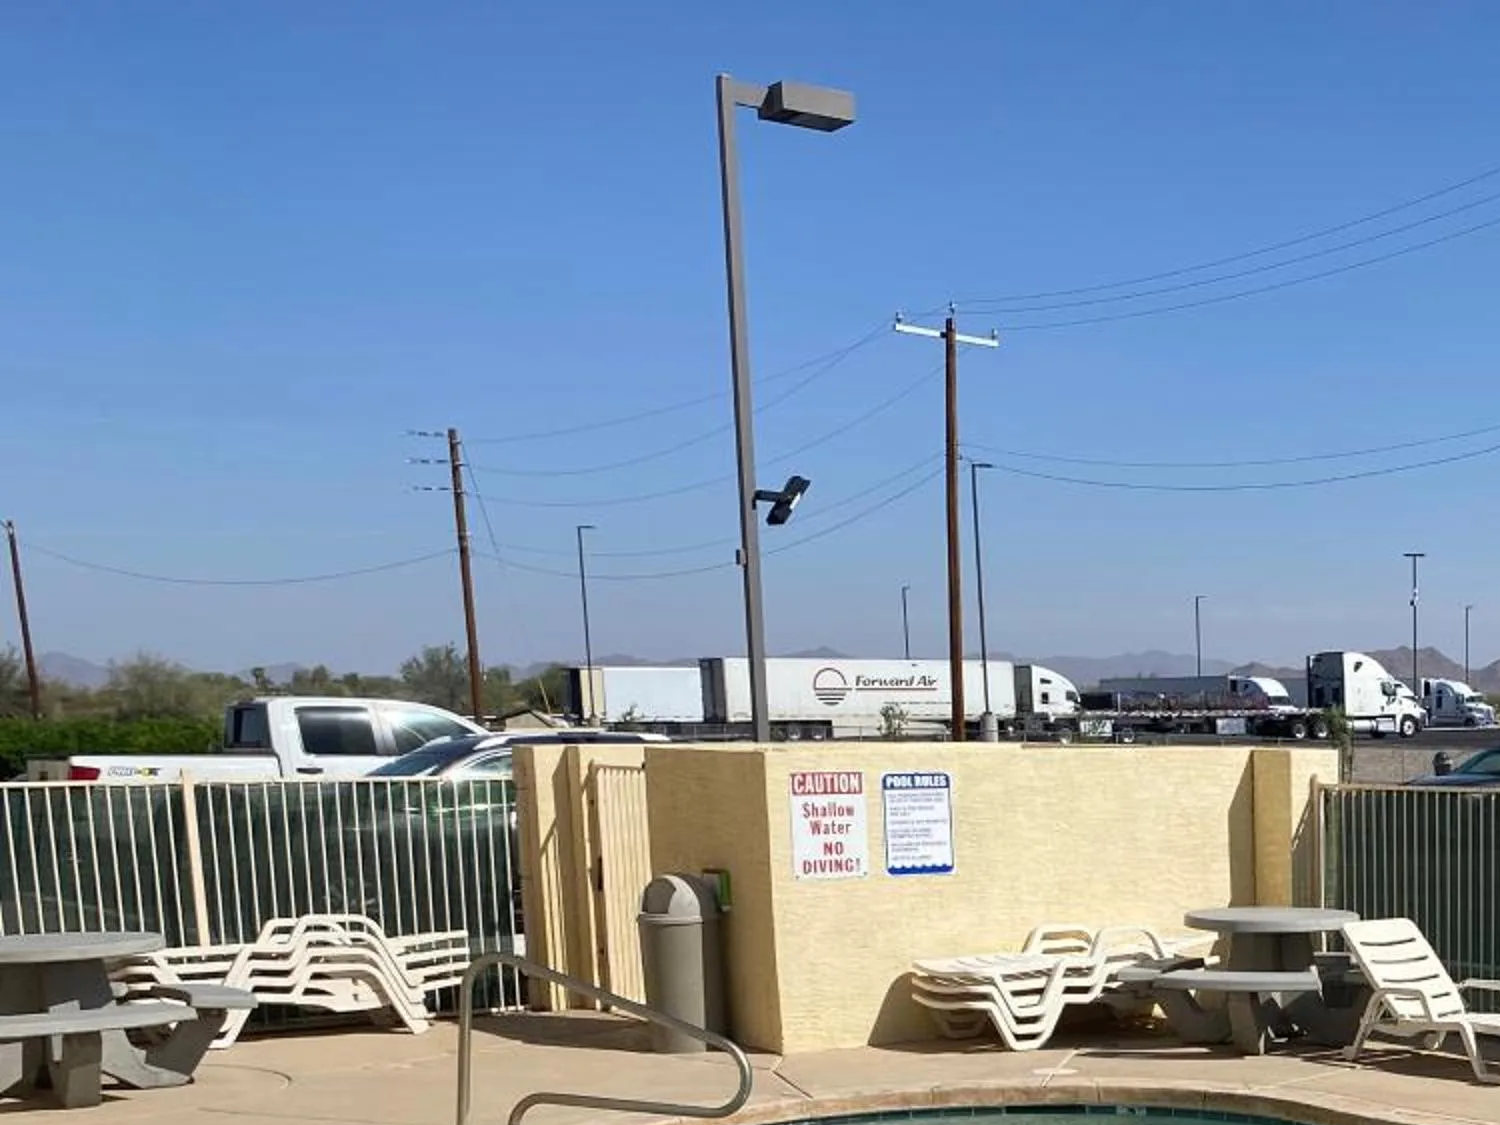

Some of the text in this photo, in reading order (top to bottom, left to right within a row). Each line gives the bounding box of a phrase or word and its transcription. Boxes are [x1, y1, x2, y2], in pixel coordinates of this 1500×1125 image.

[855, 674, 938, 687] Forward Air
[792, 773, 862, 793] CAUTION
[885, 775, 948, 788] POOL RULES
[802, 802, 855, 818] Shallow
[809, 820, 852, 836] Water
[823, 841, 844, 855] NO
[803, 858, 861, 875] DIVING!
